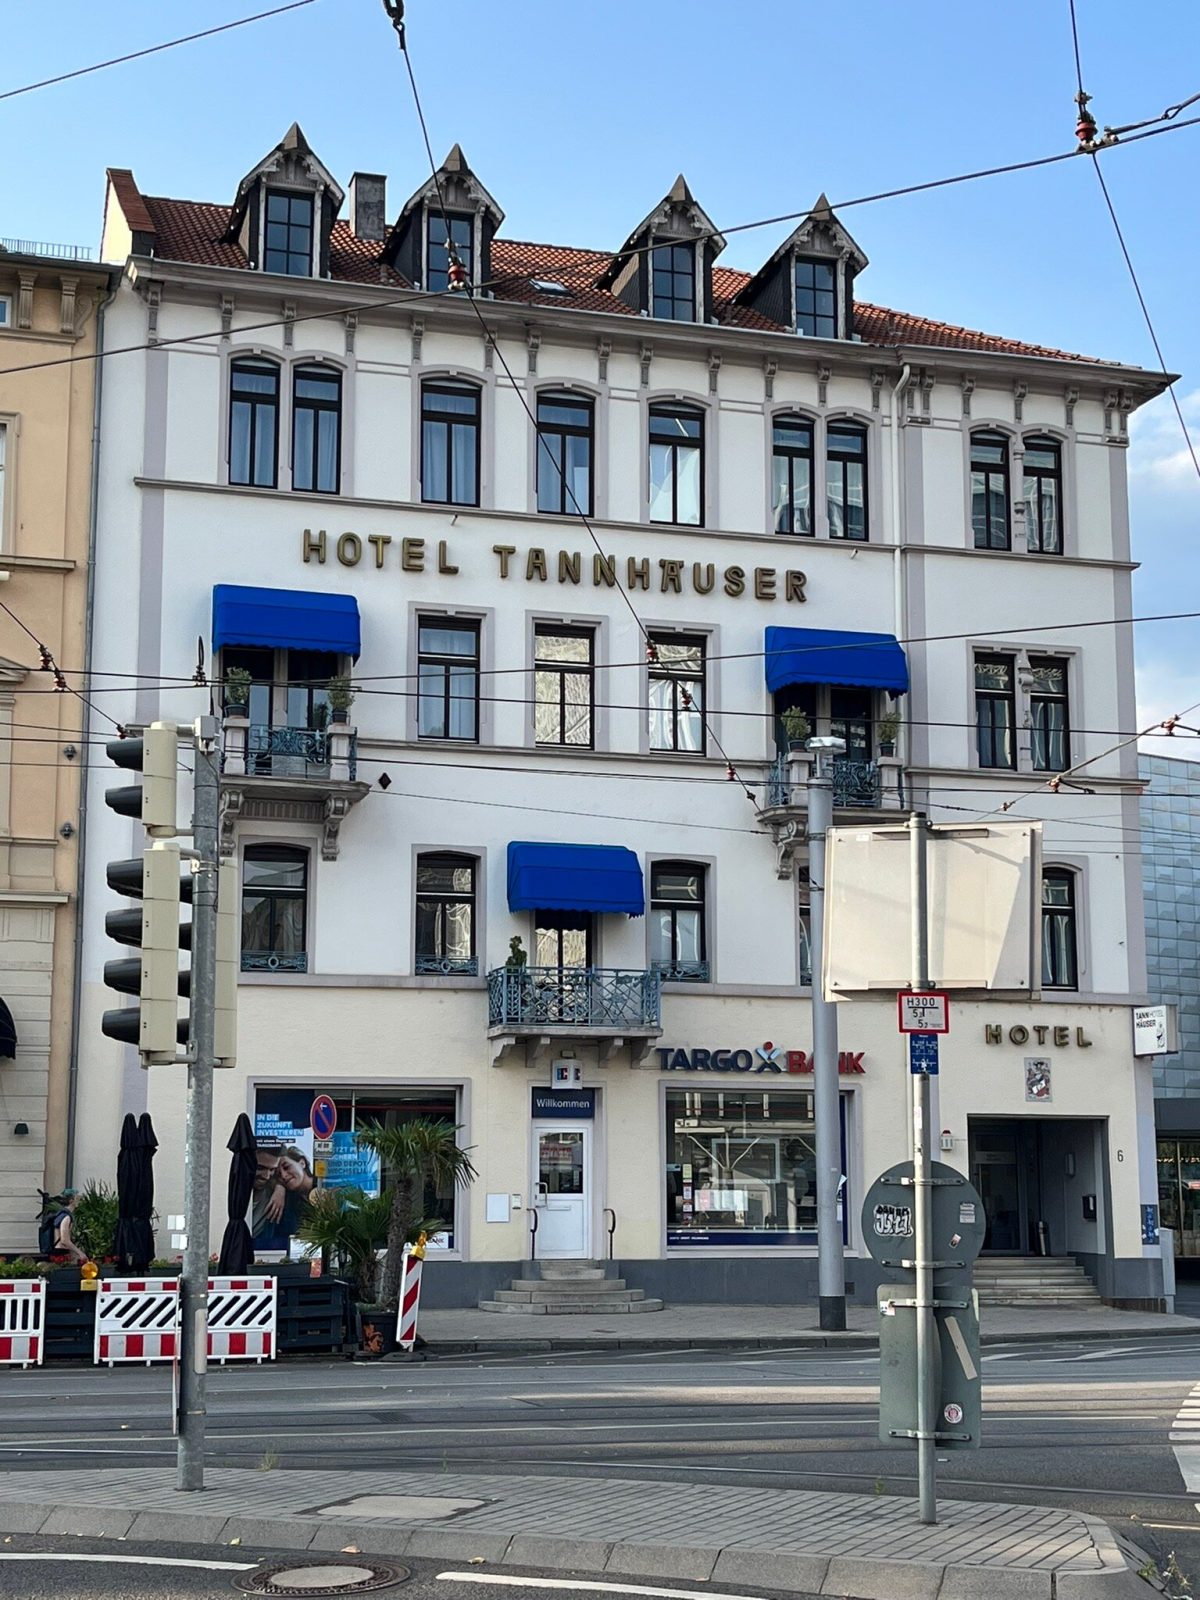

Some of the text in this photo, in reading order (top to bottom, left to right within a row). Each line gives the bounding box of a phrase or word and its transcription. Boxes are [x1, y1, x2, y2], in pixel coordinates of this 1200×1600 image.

[303, 528, 808, 603] HOTEL TANNHÄUSER
[907, 997, 935, 1006] H300
[985, 1024, 1093, 1048] HOTEL
[536, 1099, 590, 1108] Willkommen
[1117, 1149, 1124, 1162] 6
